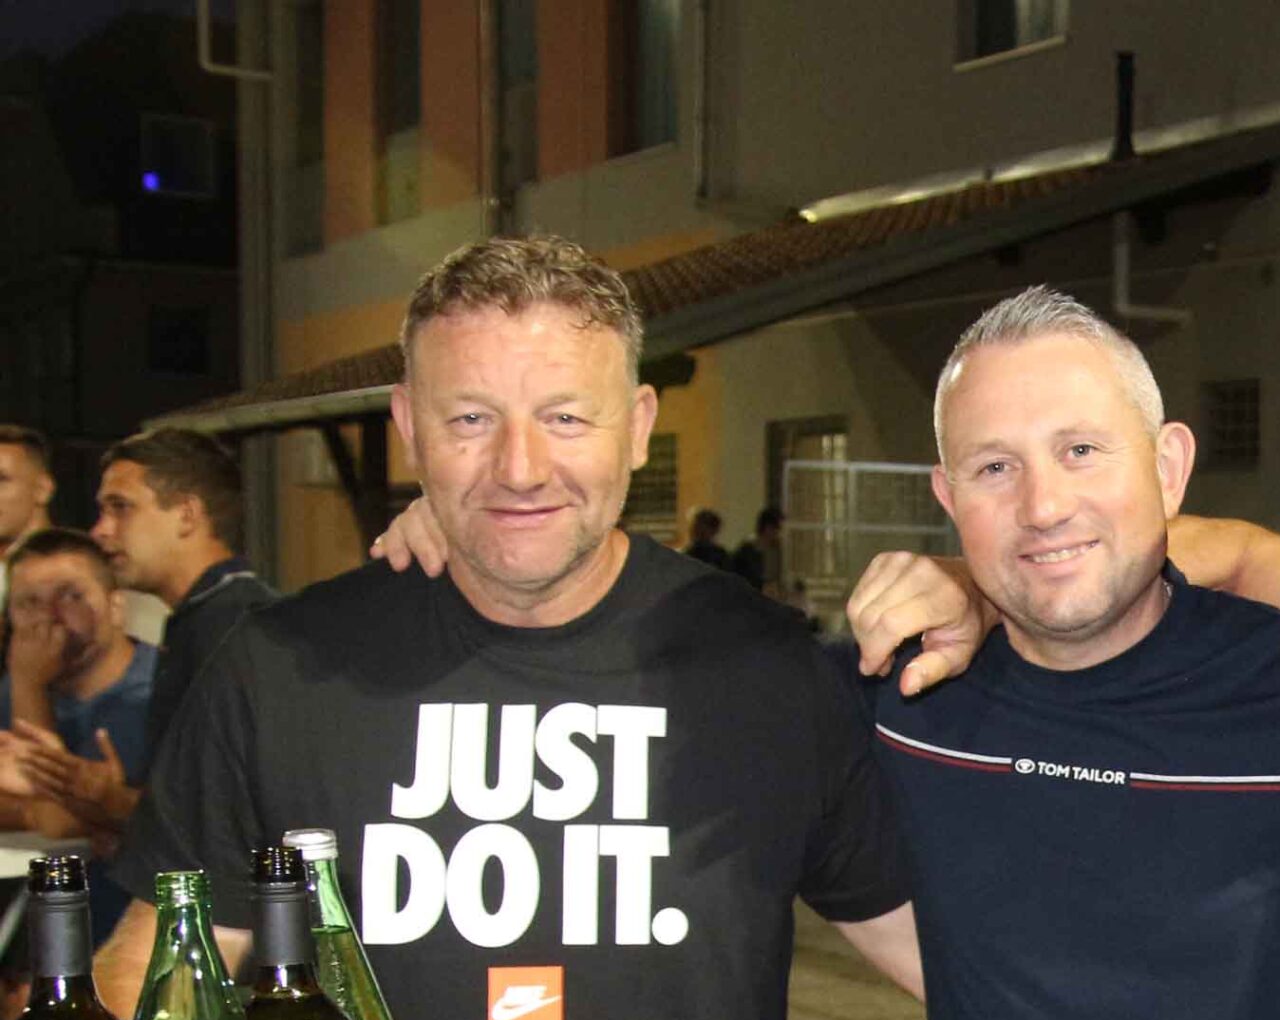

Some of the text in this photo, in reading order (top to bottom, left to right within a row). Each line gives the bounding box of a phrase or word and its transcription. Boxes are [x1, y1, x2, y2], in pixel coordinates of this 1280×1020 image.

[390, 701, 668, 822] JUST
[1037, 761, 1126, 785] TOM TAILOR
[361, 822, 690, 949] DO IT.
